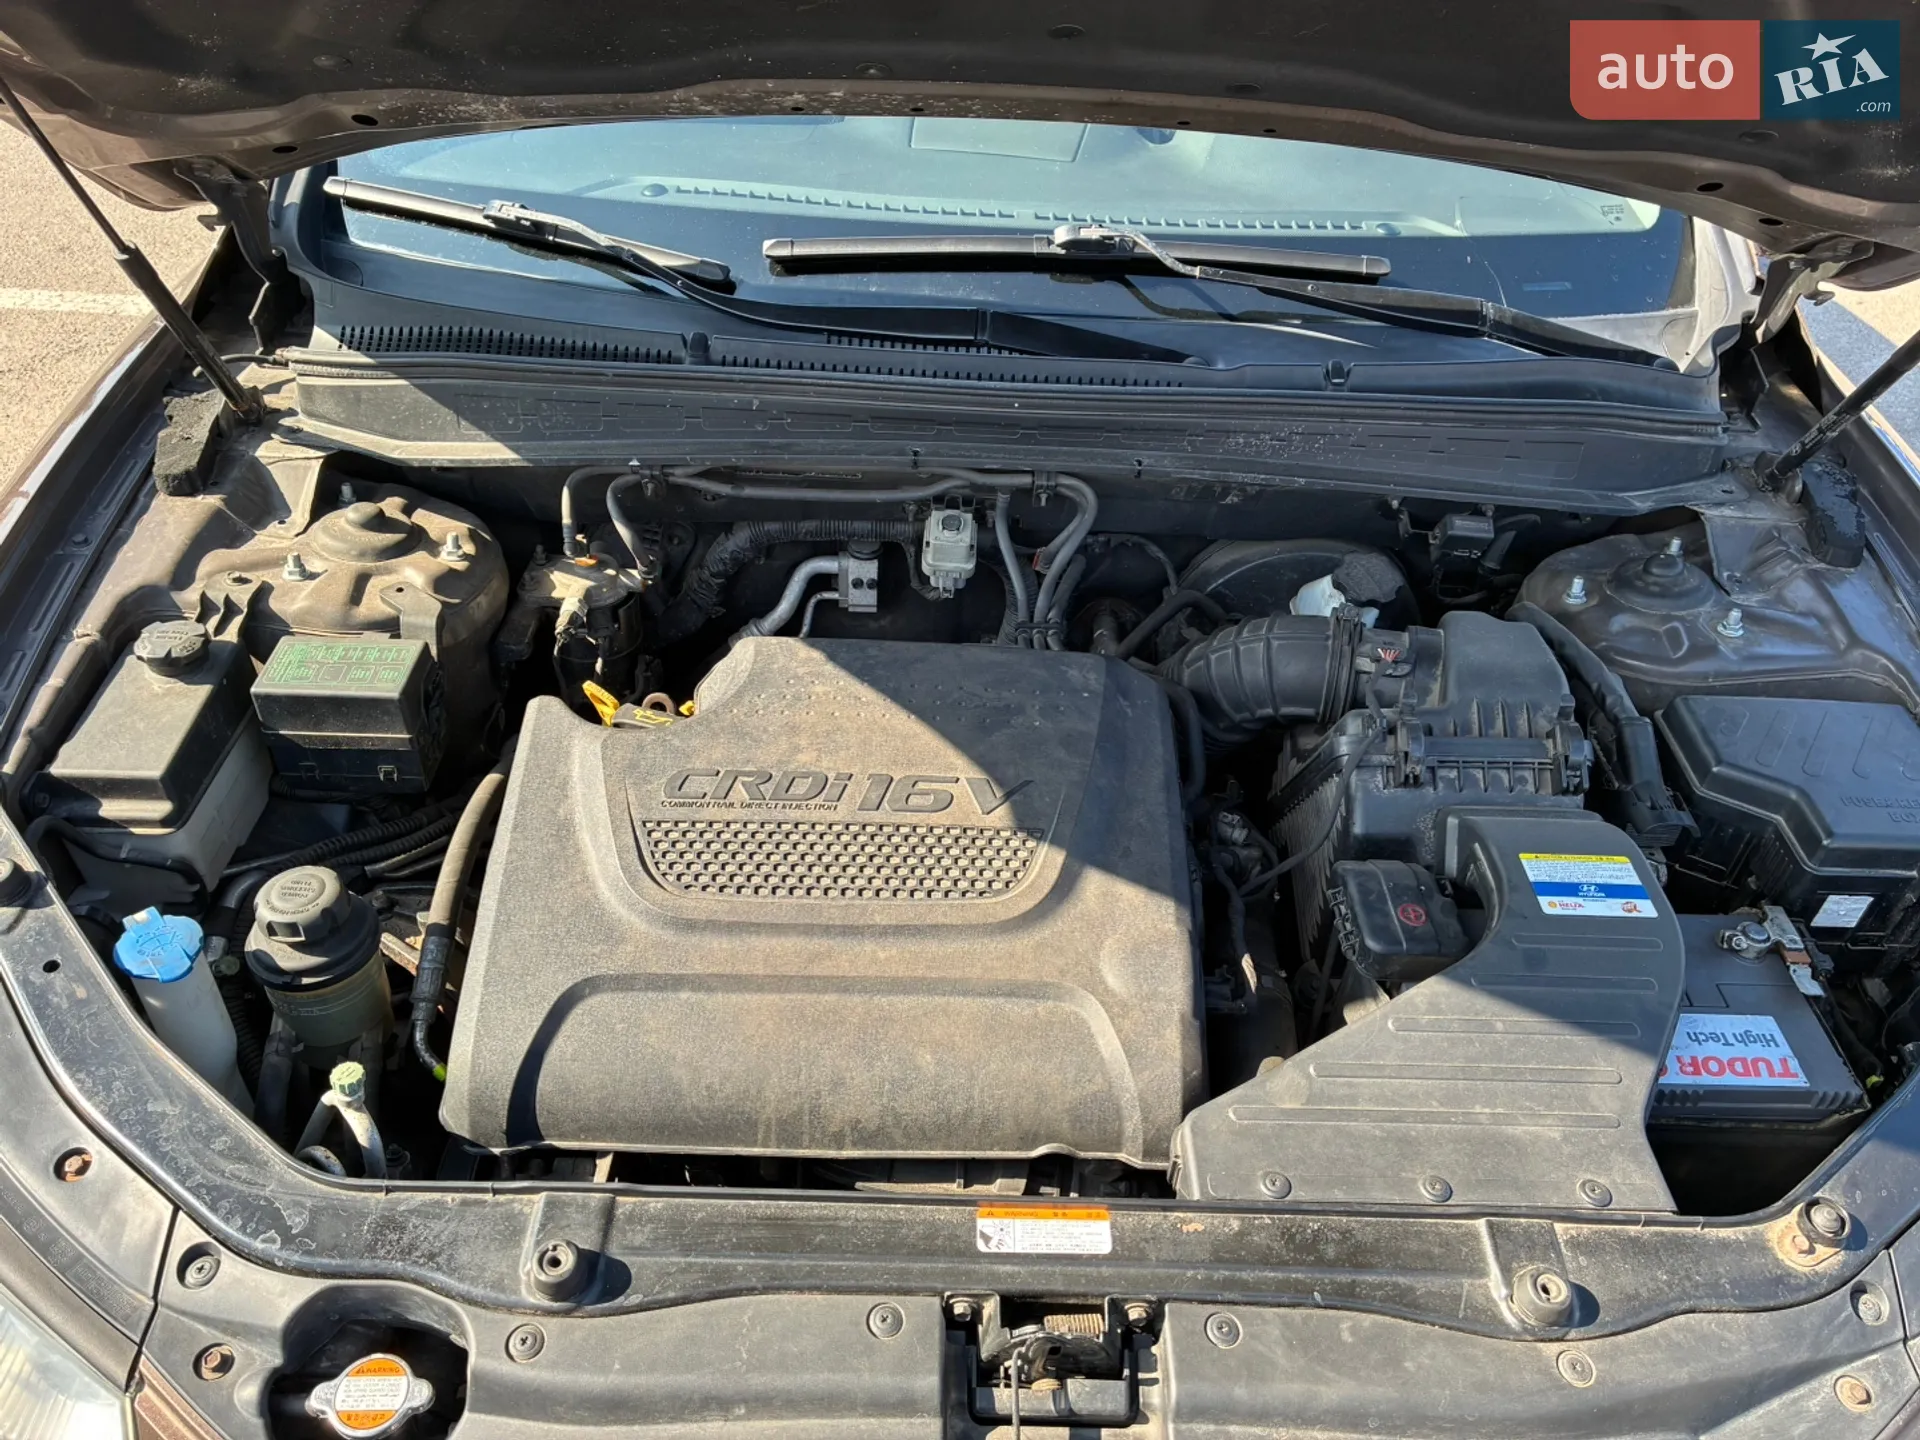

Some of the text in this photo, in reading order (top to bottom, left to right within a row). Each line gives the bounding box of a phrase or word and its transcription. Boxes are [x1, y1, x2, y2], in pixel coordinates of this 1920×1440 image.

[661, 768, 1035, 816] CRDi 16V
[739, 802, 780, 810] DIRECT
[1686, 1029, 1781, 1048] High Tech
[1675, 1054, 1800, 1079] TUDOR
